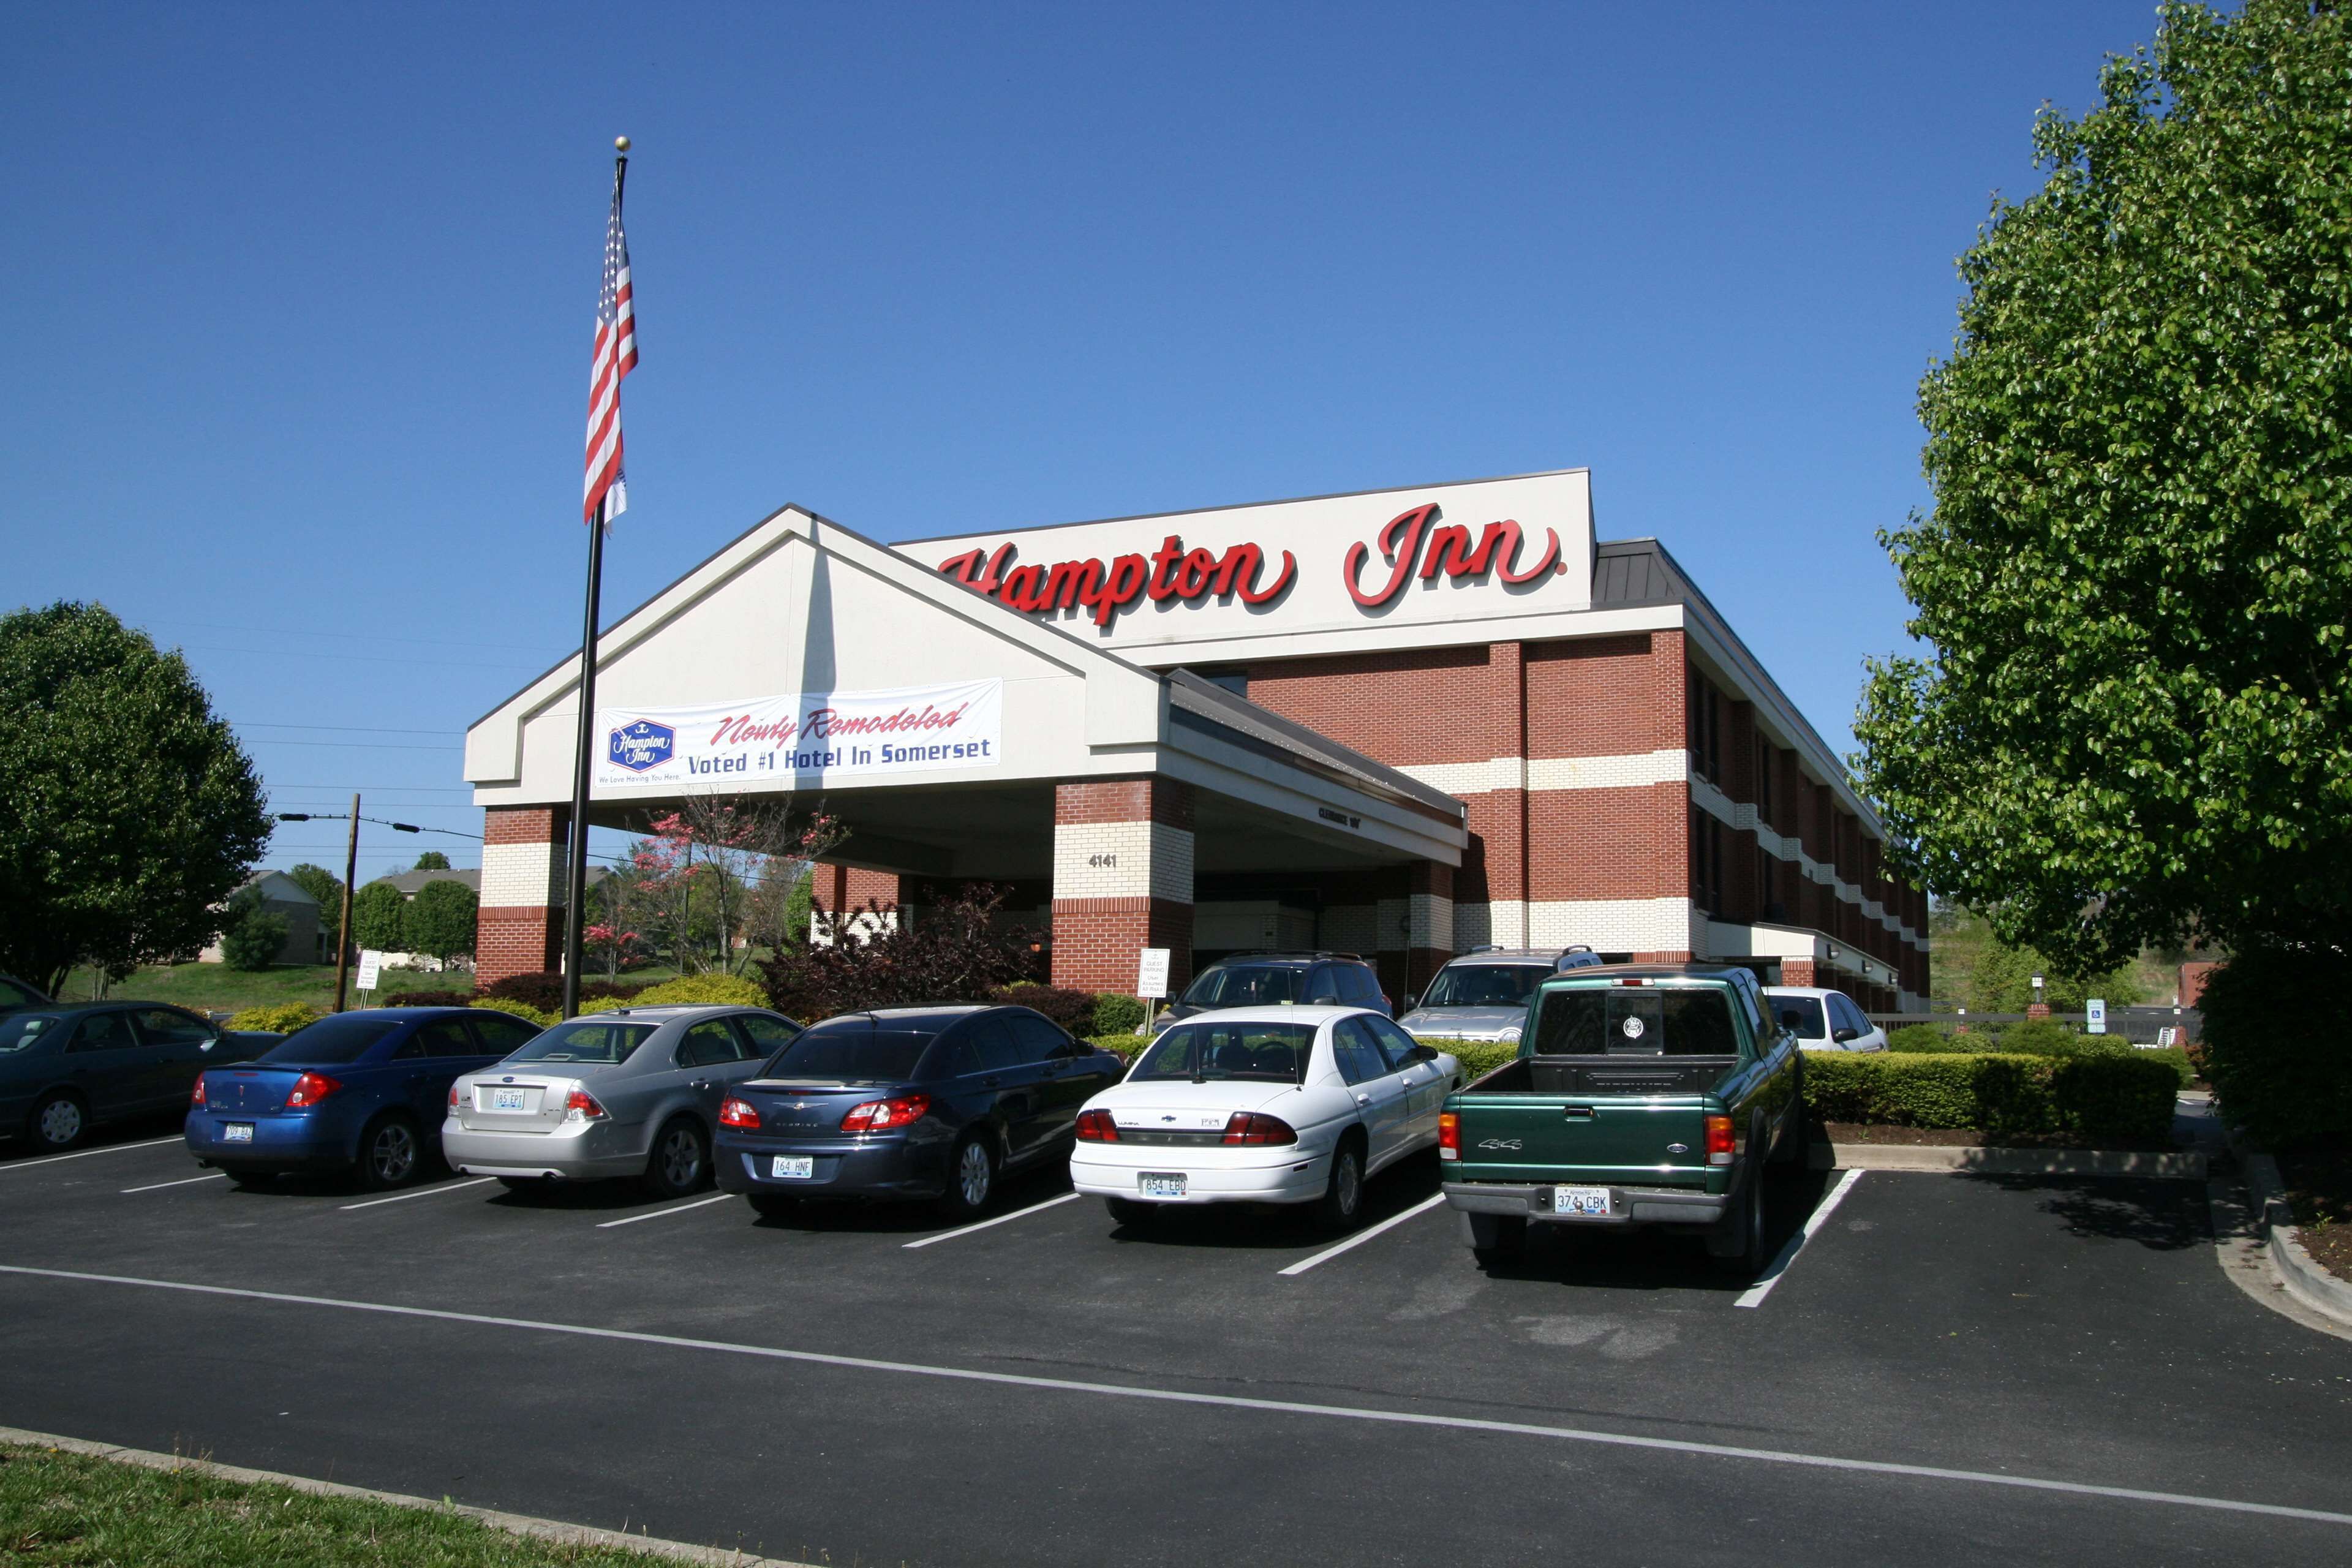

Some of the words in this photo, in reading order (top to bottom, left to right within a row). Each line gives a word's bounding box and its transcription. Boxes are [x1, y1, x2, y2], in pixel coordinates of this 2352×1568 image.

[710, 715, 799, 749] Newly
[801, 702, 968, 740] Remodeled
[613, 735, 670, 753] Hampton
[625, 748, 655, 764] Inn
[688, 753, 747, 775] Voted
[758, 751, 774, 771] #1
[785, 747, 842, 769] Hotel
[852, 746, 871, 765] In
[881, 739, 990, 763] Somerset
[1088, 854, 1117, 868] 4141
[496, 1095, 508, 1104] 185
[775, 1161, 790, 1170] 164
[1147, 1180, 1163, 1190] 854
[1169, 1180, 1186, 1191] EBD
[1586, 1196, 1607, 1208] CBK
